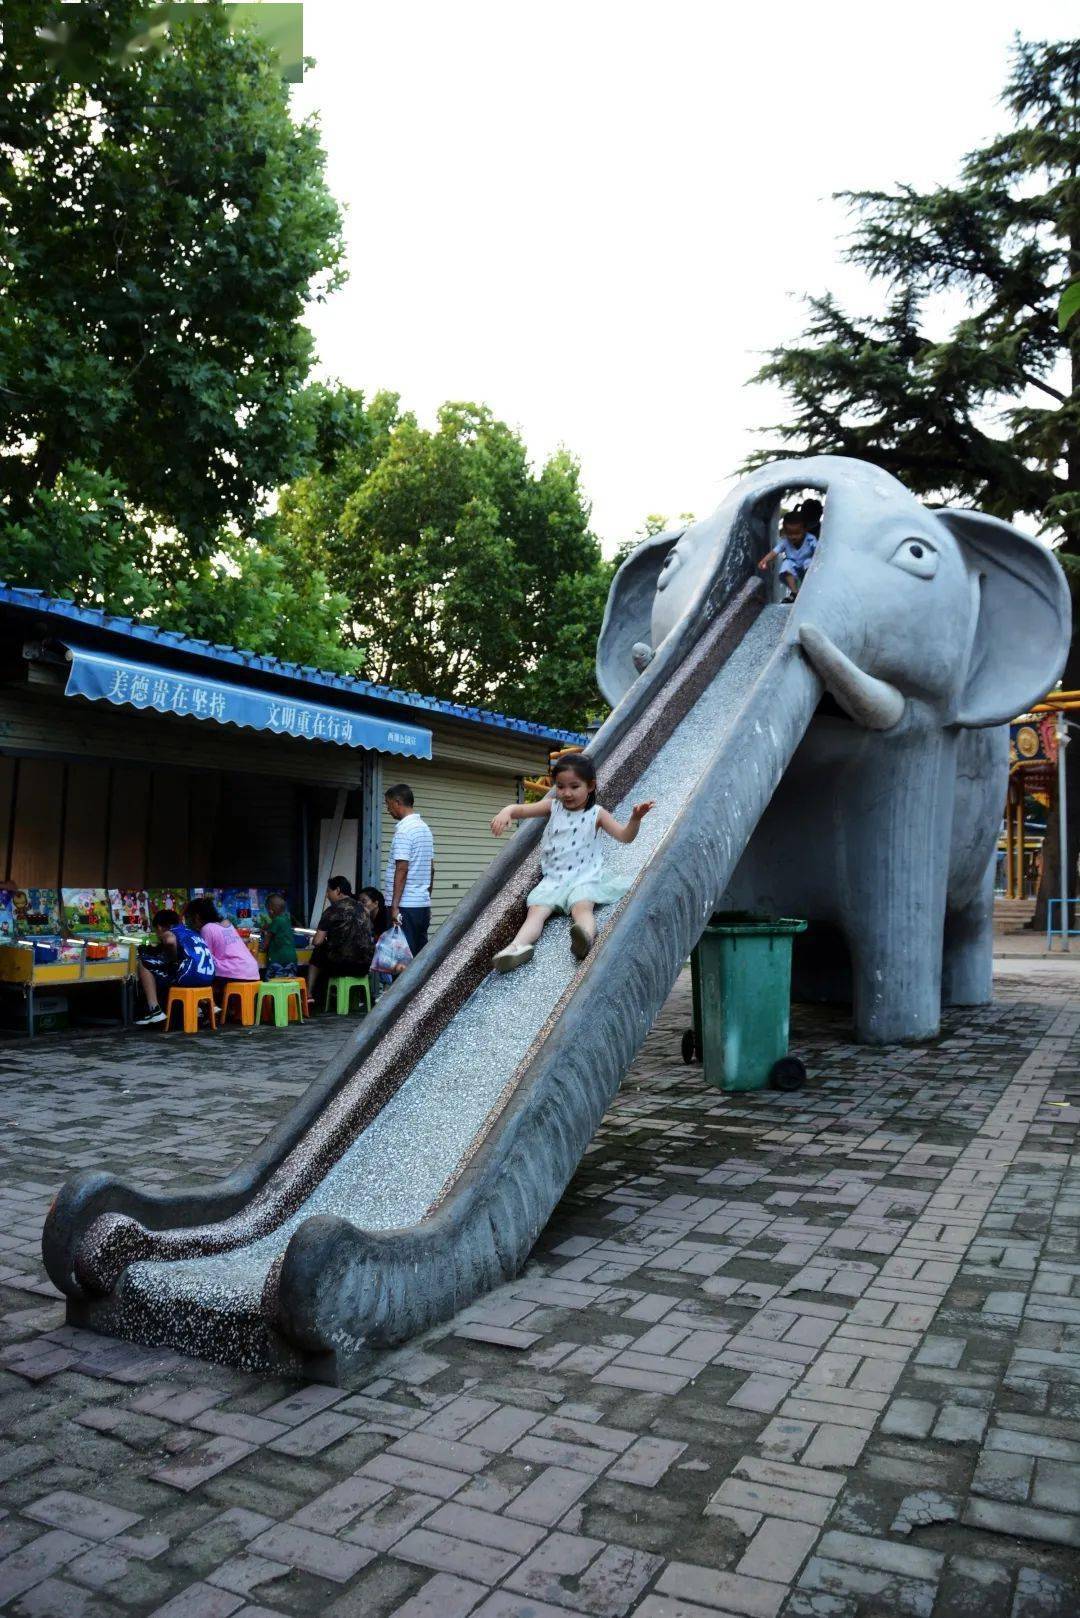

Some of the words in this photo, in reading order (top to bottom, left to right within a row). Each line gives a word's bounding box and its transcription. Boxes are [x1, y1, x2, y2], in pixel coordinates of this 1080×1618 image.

[107, 670, 226, 718] 美德贵在坚持
[265, 702, 353, 742] 文明重在行动
[193, 945, 215, 976] 23
